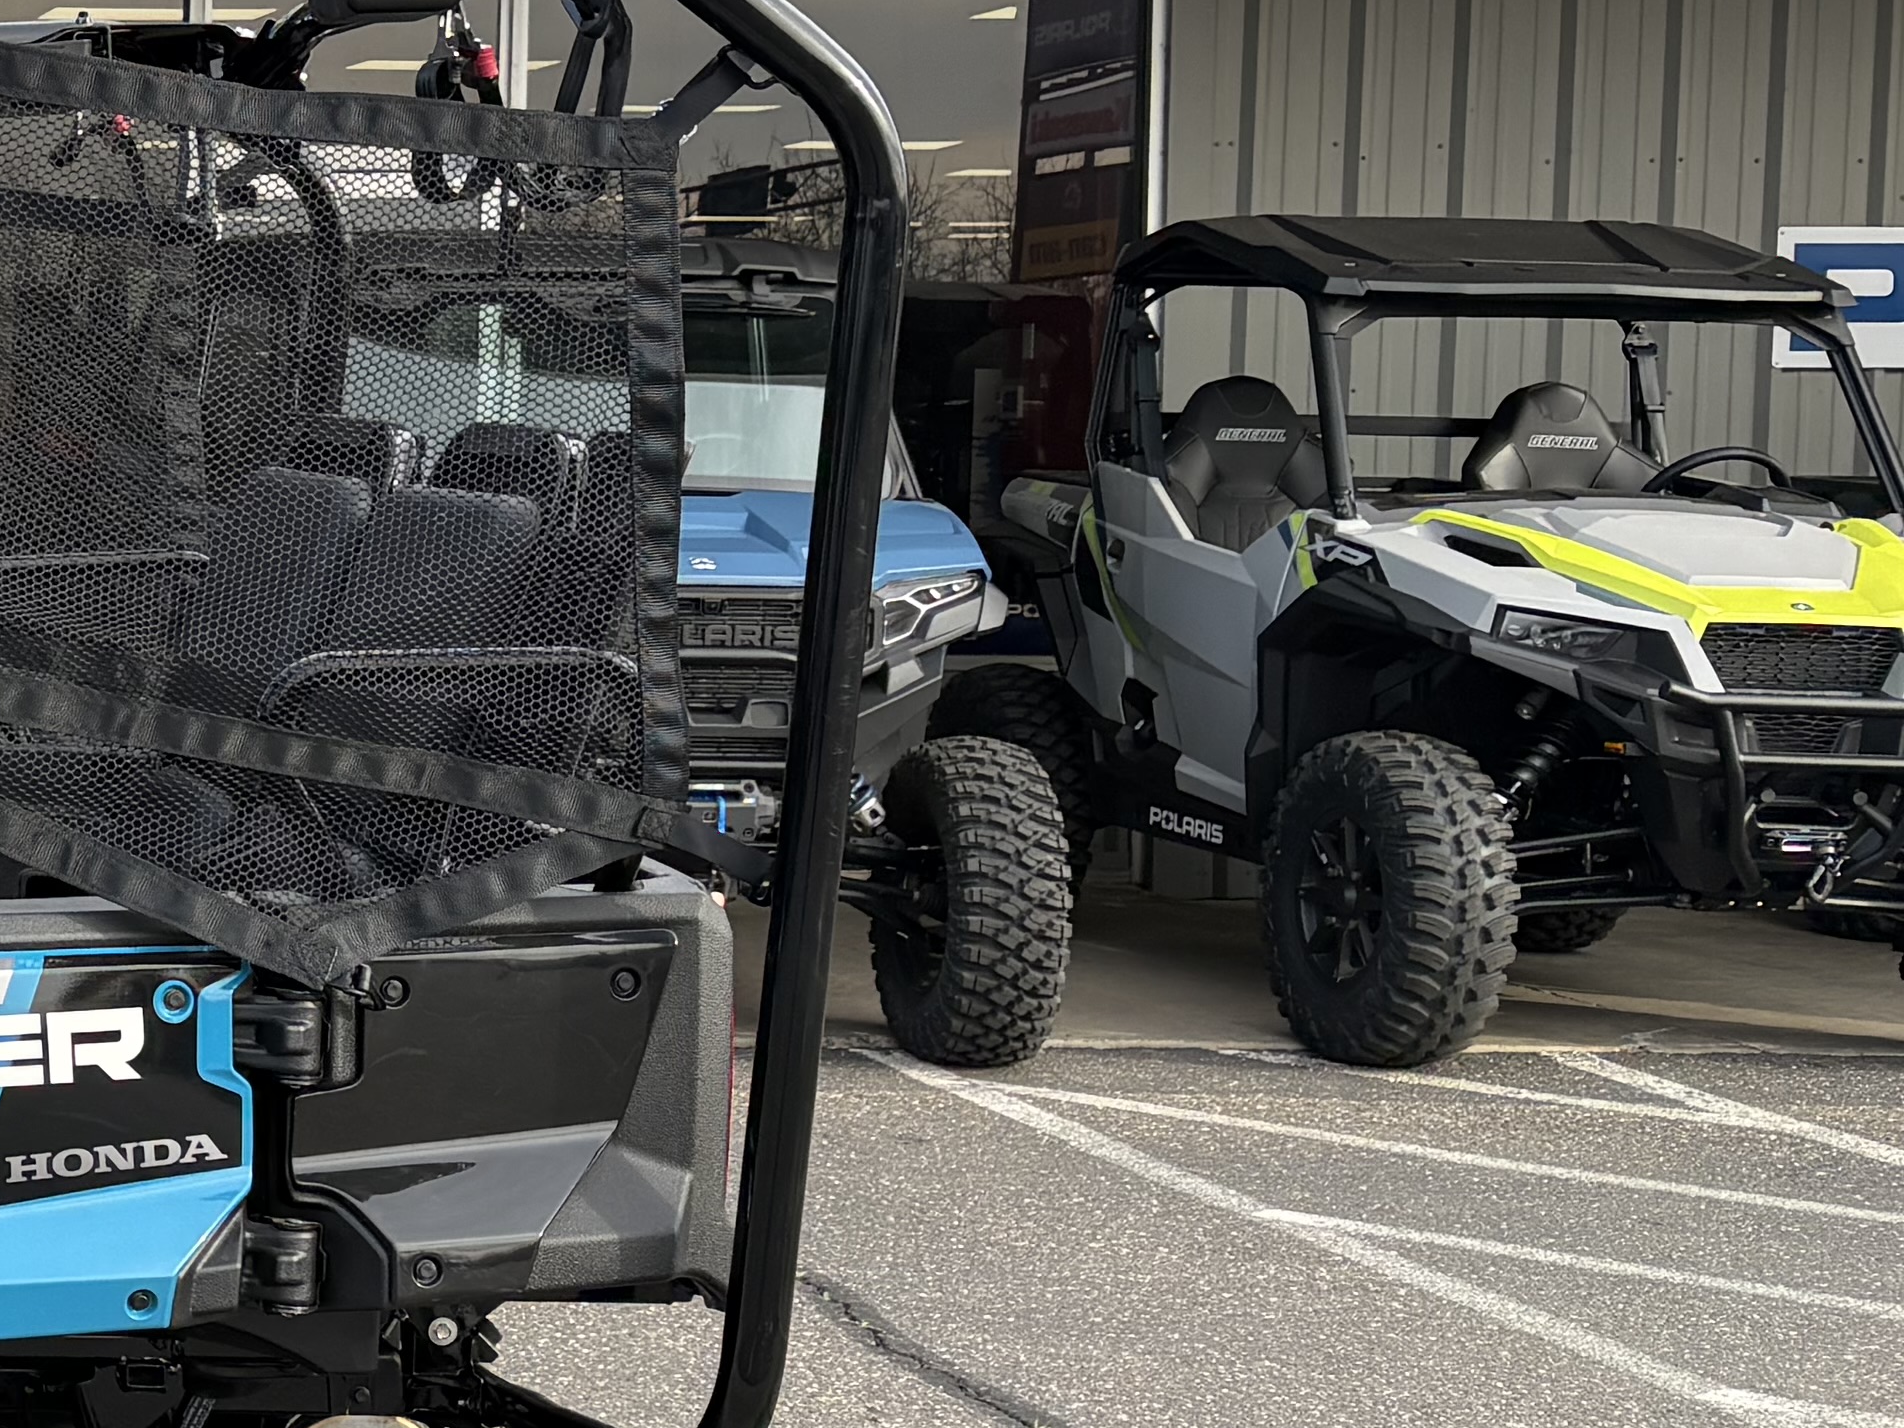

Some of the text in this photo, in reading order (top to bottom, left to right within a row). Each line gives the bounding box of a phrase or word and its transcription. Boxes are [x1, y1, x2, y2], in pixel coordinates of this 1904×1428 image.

[1216, 428, 1286, 443] GENERAL
[1527, 434, 1598, 450] GENERAL
[1304, 533, 1373, 566] XP
[678, 623, 800, 648] LARIS
[1149, 805, 1223, 844] POLARIS
[4, 1134, 228, 1184] HONDA
